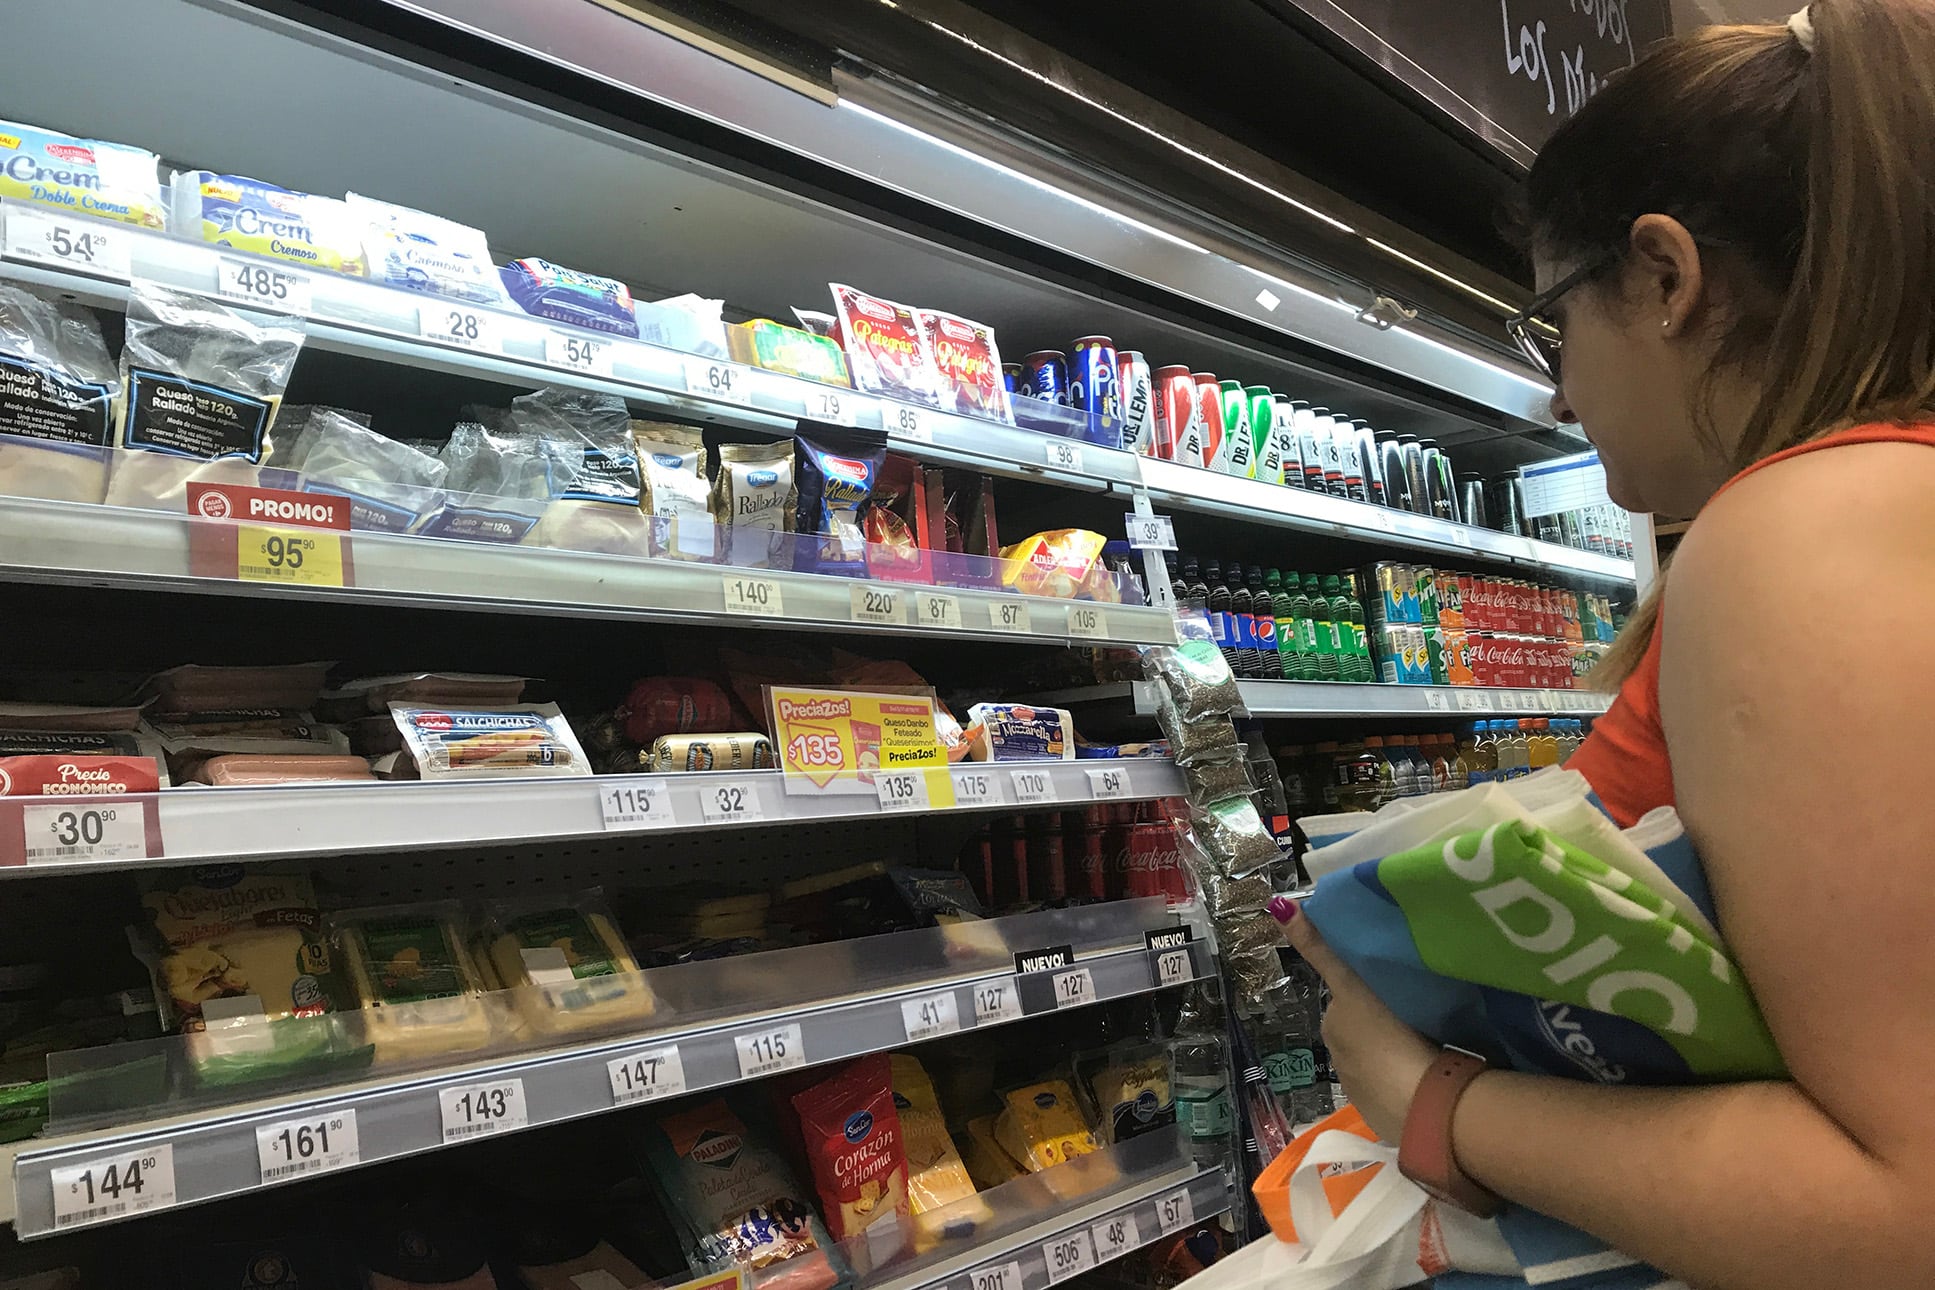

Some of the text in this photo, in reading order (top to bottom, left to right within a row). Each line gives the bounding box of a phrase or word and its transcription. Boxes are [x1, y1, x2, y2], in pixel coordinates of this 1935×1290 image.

[30, 184, 130, 216] Doble Crema
[270, 240, 318, 261] Cremoso
[0, 386, 39, 400] allado
[156, 386, 193, 403] Queso
[151, 396, 196, 416] Rallado
[249, 498, 333, 523] PROMO!
[738, 494, 784, 515] Rallado
[780, 700, 851, 720] PreciaZos!
[456, 716, 533, 729] SALCHICHAS
[883, 718, 929, 728] Queso Danbo
[1002, 722, 1051, 742] Mozzarella
[893, 729, 922, 738] Feteado
[889, 748, 937, 762] PreciaZos!
[58, 763, 111, 782] Precio
[42, 780, 127, 795] ECONÓMICO
[277, 910, 314, 926] Fetas
[1150, 932, 1186, 950] NUEVO!
[1021, 952, 1065, 973] NUEVO!
[847, 1118, 872, 1137] SanCor
[834, 1130, 893, 1178] Corazón
[841, 1151, 892, 1189] de Horma
